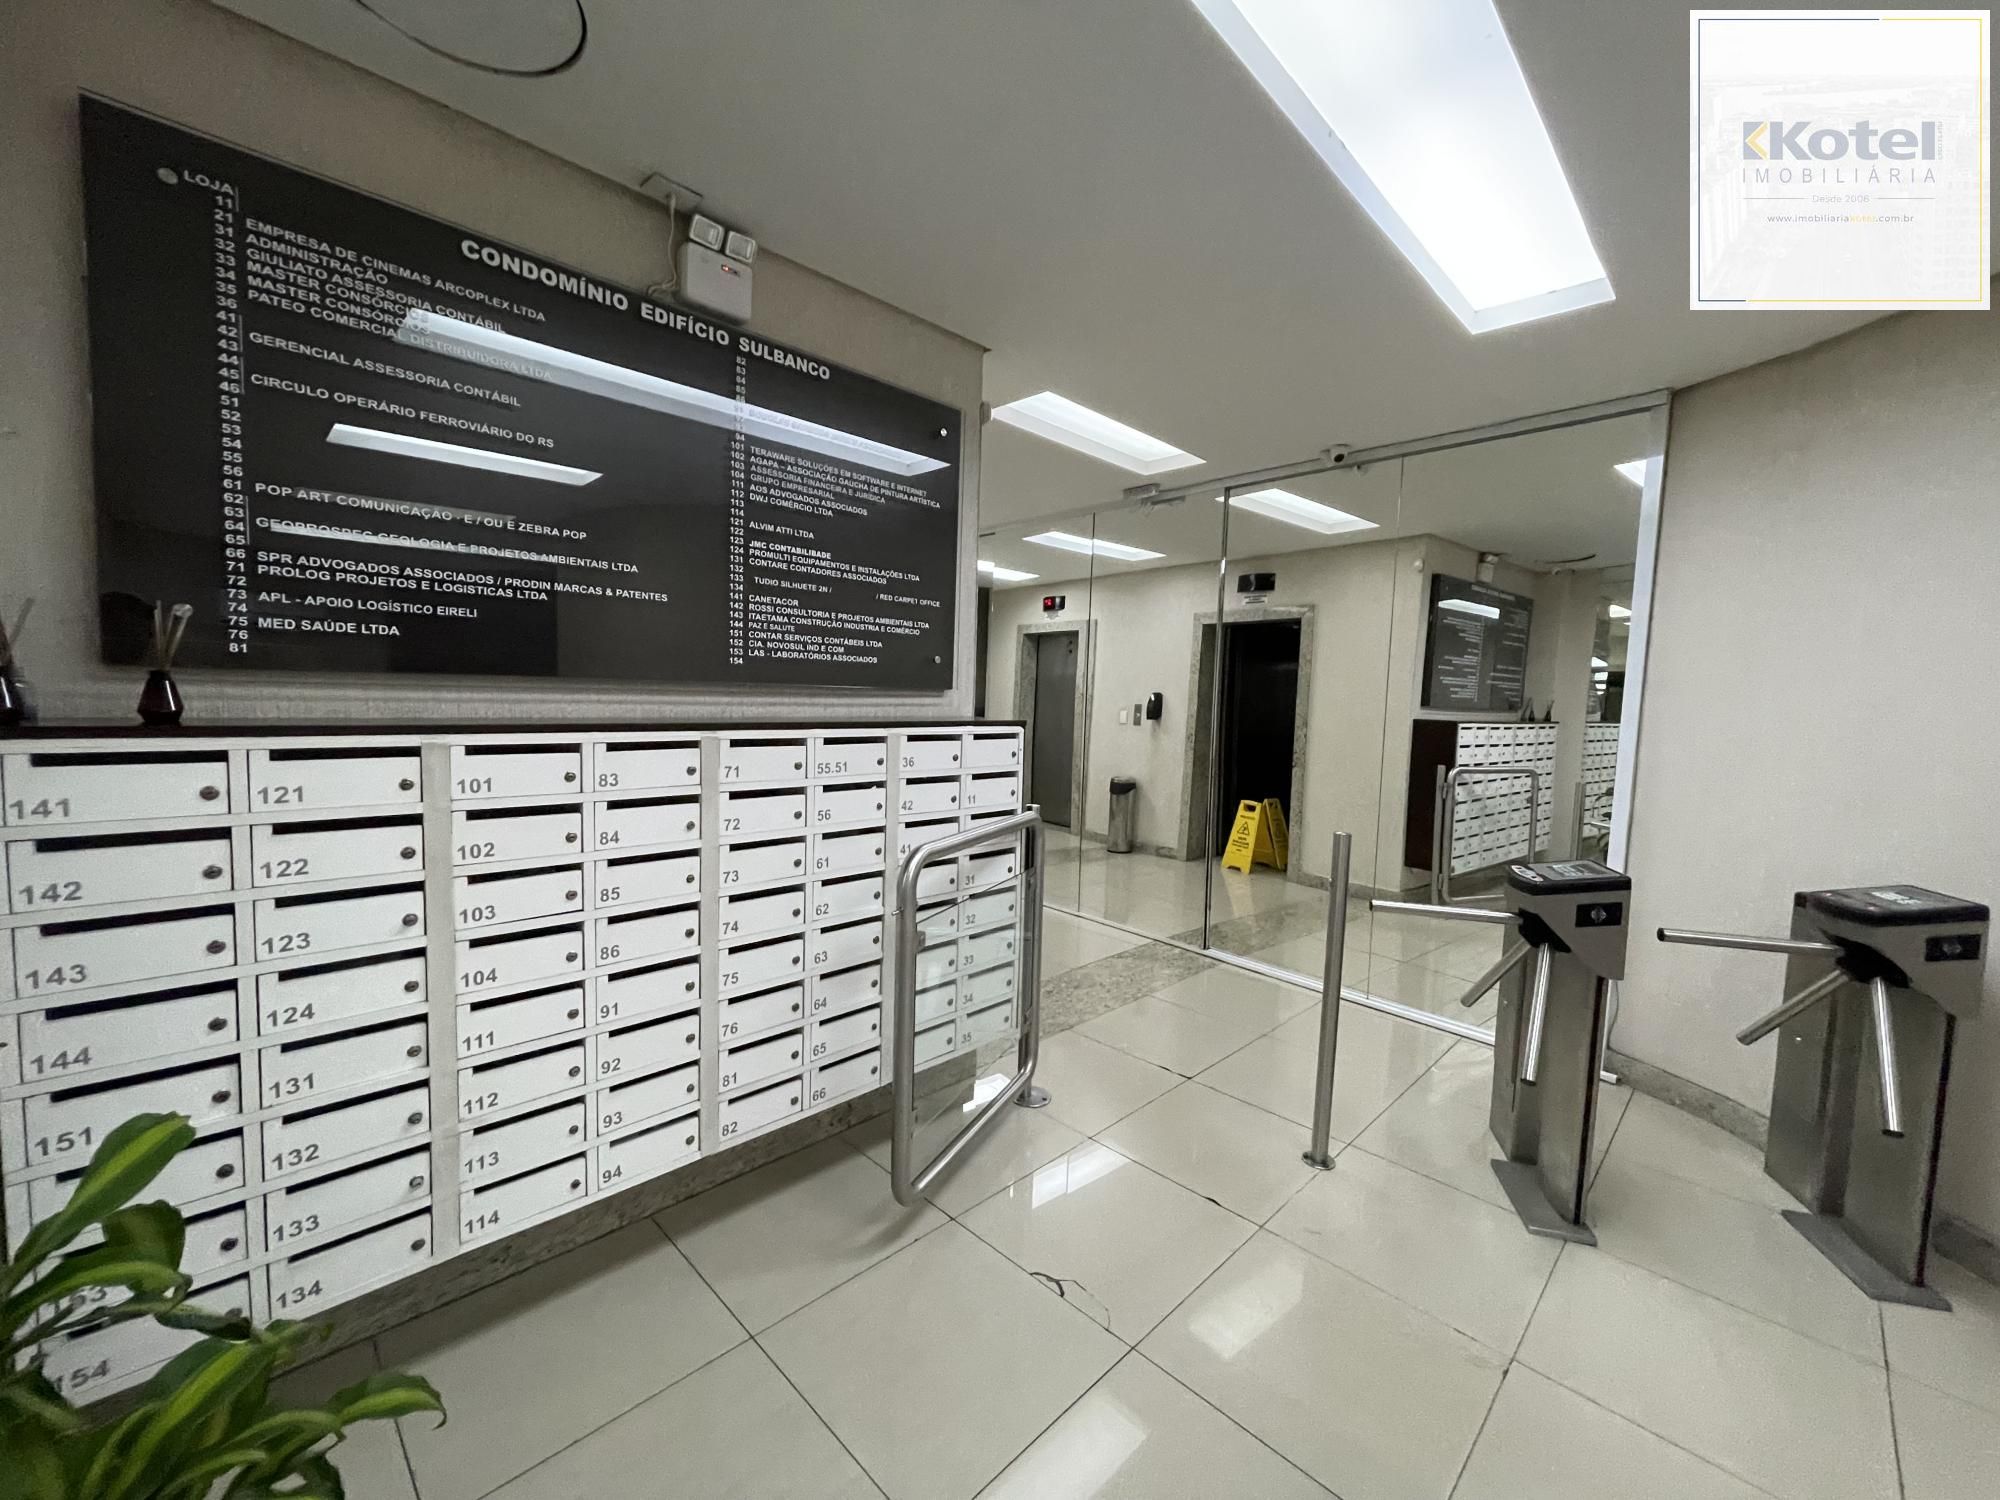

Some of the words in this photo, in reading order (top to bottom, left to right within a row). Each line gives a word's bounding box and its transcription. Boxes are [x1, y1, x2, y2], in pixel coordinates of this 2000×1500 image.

[183, 169, 234, 195] LOJA
[215, 196, 233, 209] 11
[214, 209, 233, 223] 21
[214, 223, 233, 237] 31
[215, 238, 235, 252] 32
[215, 252, 236, 266] 33
[245, 233, 388, 285] ADMINISTRAÇÃO
[215, 266, 236, 281] 34
[245, 217, 332, 254] EMPRESA
[335, 246, 358, 262] DE
[362, 254, 432, 286] CINEMAS
[434, 279, 511, 311] ARCOPLEX
[513, 303, 546, 322] LTDA
[247, 261, 321, 291] MASTER
[216, 281, 237, 295] 35
[246, 248, 328, 280] GIULIATO
[331, 274, 433, 312] ASSESSORIA
[436, 303, 507, 335] CONTÁBIL
[247, 275, 321, 304] MASTER
[248, 289, 306, 313] PATEO
[310, 307, 405, 342] COMERCIAL
[460, 238, 629, 312] CONDOMÍNIO
[641, 302, 730, 347] EDIFÍCIO
[738, 337, 830, 380] SULBANCO
[249, 332, 350, 365] GERENCIAL
[353, 358, 450, 390] ASSESSORIA
[453, 382, 521, 407] CONTÁBIL
[251, 373, 329, 399] CIRCULO
[333, 391, 416, 418] OPERÁRIO
[420, 410, 513, 439] FERROVIÁRIO
[516, 432, 535, 444] DO
[537, 436, 554, 448] RS
[255, 482, 292, 497] POP
[296, 489, 332, 503] ART
[464, 514, 473, 524] E
[483, 517, 503, 528] OU
[518, 522, 560, 537] ZEBRA
[563, 529, 587, 540] POP
[750, 492, 768, 503] DWJ
[770, 497, 813, 512] COMÉRCIO
[814, 507, 833, 517] LTDA
[769, 488, 820, 505] ADVOGADOS
[821, 500, 868, 516] ASSOCIADOS
[749, 521, 774, 531] ALVIM
[776, 526, 793, 535] ATTI
[795, 530, 814, 539] LTDA
[749, 540, 767, 549] JMC
[458, 543, 467, 552] E
[470, 544, 537, 561] PROJETOS
[541, 553, 609, 569] AMBIENTAIS
[611, 562, 639, 573] LTDA
[749, 548, 791, 561] PROMULTI
[792, 555, 849, 571] EQUIPAMENTOS
[904, 573, 920, 581] LTDA
[257, 551, 293, 565] SPR
[296, 555, 400, 576] ADVOGADOS
[403, 567, 494, 585] ASSOCIADOS
[504, 577, 551, 591] PRODIN
[554, 582, 603, 596] MARCAS
[605, 587, 613, 596] &
[616, 588, 668, 602] PATENTES
[749, 558, 788, 570] CONTARE
[790, 564, 841, 578] CONTADORES
[843, 572, 887, 584] ASSOCIADOS
[257, 564, 331, 581] PROLOG
[335, 571, 417, 589] PROJETOS
[421, 580, 430, 590] E
[434, 582, 513, 598] LOGISTICAS
[517, 588, 548, 601] LTDA
[754, 576, 779, 586] TUDIO
[781, 580, 817, 592] SILHUETE
[227, 588, 247, 600] 73
[749, 594, 799, 607] CANETACOR
[227, 602, 248, 613] 74
[258, 591, 291, 604] APL
[304, 595, 353, 609] APOIO
[357, 598, 433, 615] LOGÍSTICO
[437, 605, 477, 618] EIRELI
[228, 615, 248, 626] 75
[749, 603, 774, 613] ROSSI
[776, 607, 830, 618] CONSULTORIA
[838, 613, 874, 623] PROJETOS
[875, 617, 913, 627] AMBIENTAIS
[914, 621, 929, 629] LTDA
[228, 629, 248, 640] 76
[258, 617, 296, 630] MED
[301, 619, 357, 634] SAÚDE
[361, 623, 400, 636] LTDA
[749, 631, 782, 641] CONTAR
[784, 633, 823, 643] SERVIÇOS
[229, 642, 248, 653] 81
[749, 649, 765, 657] LAS
[771, 651, 831, 661] LABORATÓRIOS
[833, 654, 878, 663] ASSOCIADOS
[724, 765, 740, 778] 71
[817, 761, 848, 775] 55.51
[902, 756, 915, 768] 36
[456, 777, 492, 794] 101
[599, 773, 619, 788] 83
[258, 785, 305, 806] 121
[901, 799, 914, 811] 42
[967, 794, 977, 805] 11
[9, 798, 71, 820] 141
[817, 809, 831, 821] 56
[724, 818, 741, 832] 72
[599, 830, 620, 845] 84
[457, 842, 495, 861] 102
[900, 843, 911, 855] 41
[260, 858, 310, 880] 122
[723, 870, 739, 884] 73
[965, 874, 975, 886] 31
[19, 881, 83, 905] 142
[600, 887, 620, 902] 85
[459, 905, 496, 923] 103
[816, 903, 830, 916] 62
[722, 921, 739, 935] 74
[965, 913, 976, 926] 32
[261, 933, 311, 955] 123
[25, 963, 88, 990] 143
[460, 967, 498, 988] 104
[266, 1003, 316, 1028] 124
[600, 1002, 619, 1019] 91
[462, 1031, 495, 1052] 111
[30, 1047, 93, 1076] 144
[269, 1073, 316, 1098] 131
[463, 1092, 499, 1115] 112
[34, 1126, 95, 1157] 151
[271, 1144, 320, 1172] 132
[273, 1215, 321, 1242] 133
[276, 1280, 324, 1309] 134
